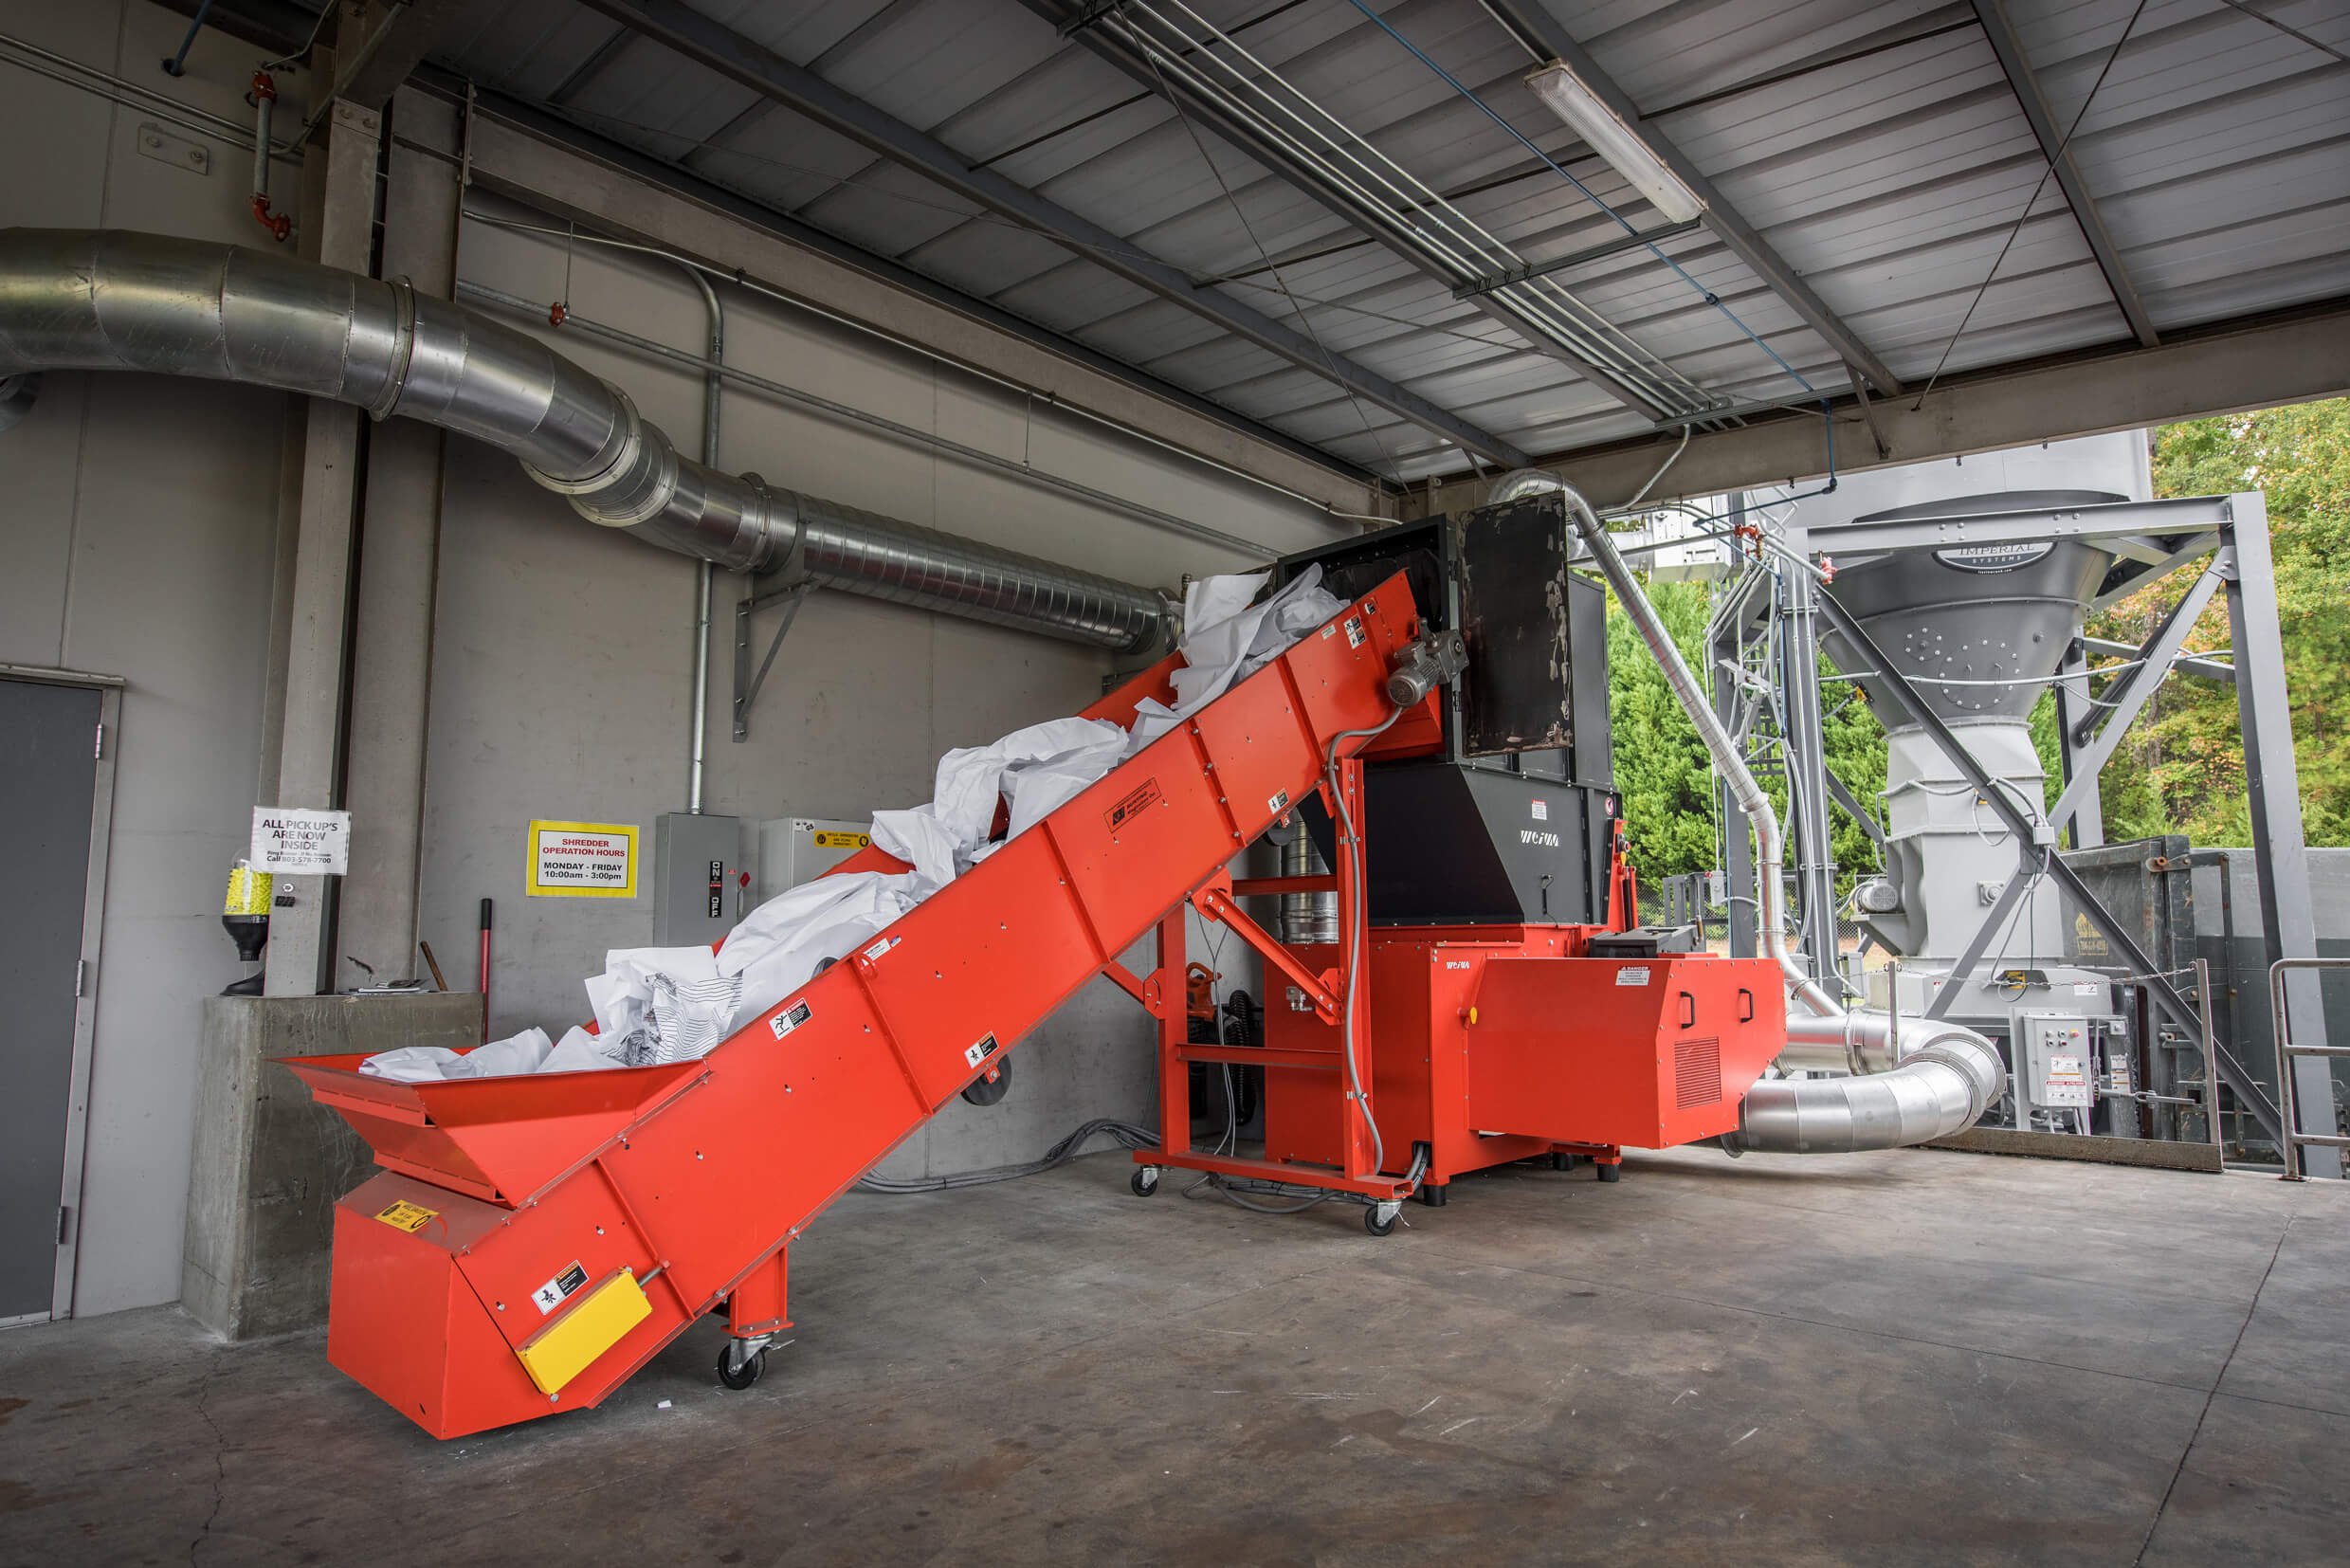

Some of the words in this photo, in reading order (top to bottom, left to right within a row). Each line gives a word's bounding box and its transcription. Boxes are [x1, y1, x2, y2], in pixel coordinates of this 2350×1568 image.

[1959, 545, 2033, 555] IMPERIAL
[1973, 556, 2021, 564] SYSTEMS
[263, 819, 284, 830] ALL
[286, 820, 312, 830] PICK
[314, 821, 338, 831] UP'S
[272, 830, 296, 839] ARE
[297, 831, 326, 841] NOW
[281, 841, 319, 850] INSIDE
[562, 838, 610, 848] SHREDDER
[542, 848, 594, 856] OPERATION
[544, 862, 585, 870] MONDAY
[712, 862, 720, 877] ON
[591, 872, 622, 881] 3:00pm
